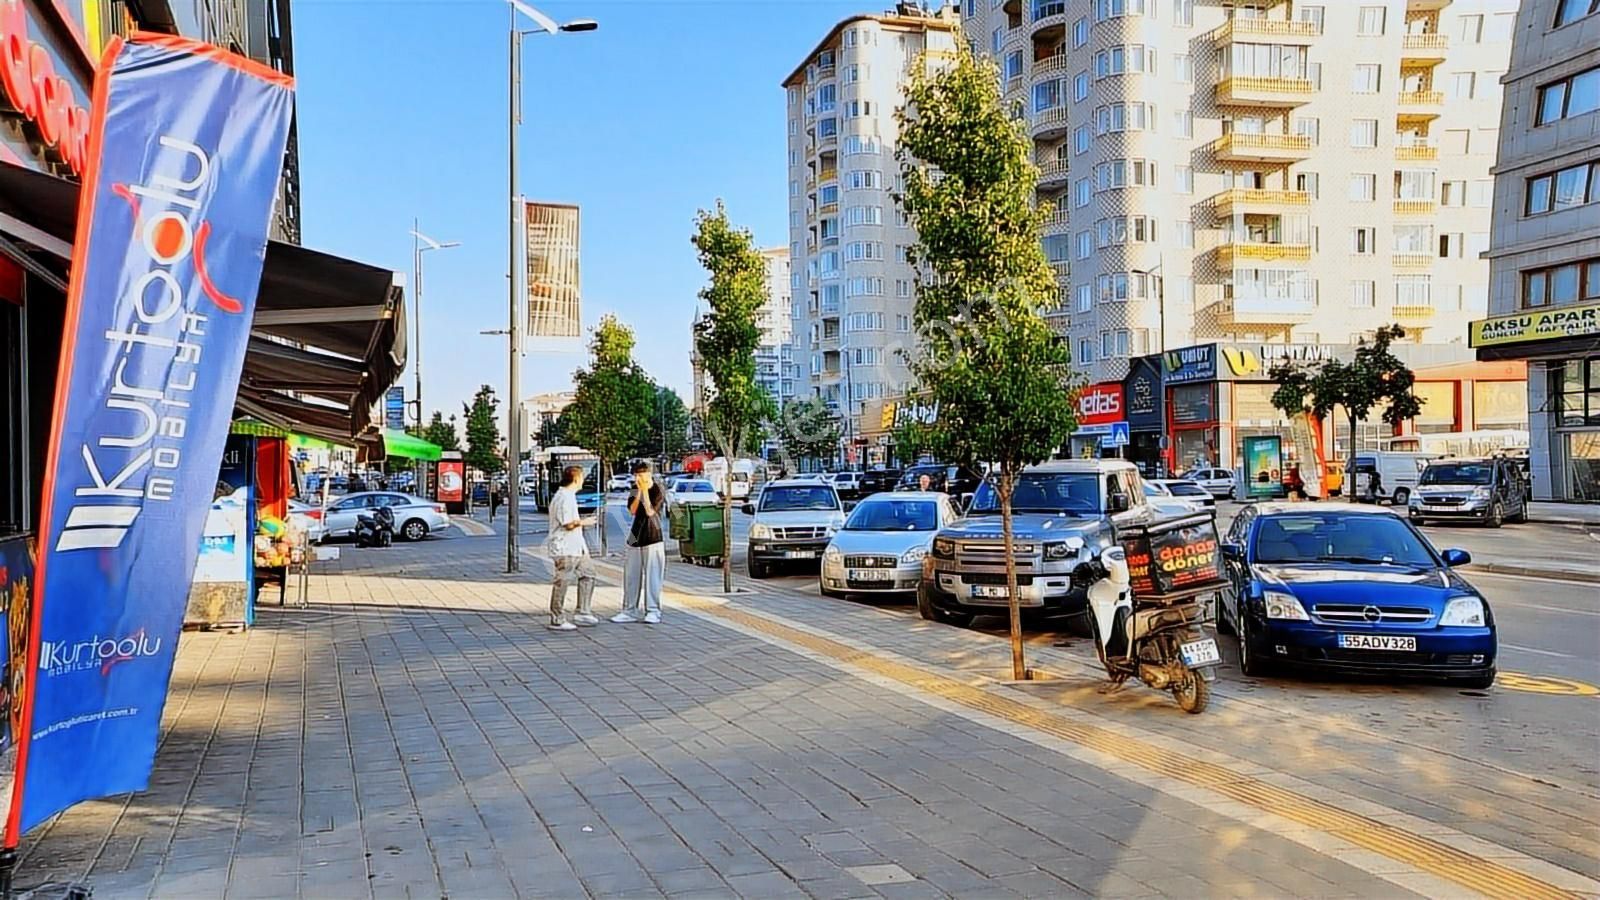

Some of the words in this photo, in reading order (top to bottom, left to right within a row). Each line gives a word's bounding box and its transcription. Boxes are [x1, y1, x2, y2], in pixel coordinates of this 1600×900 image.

[1482, 317, 1532, 333] AKSU
[1160, 540, 1216, 561] donas
[1163, 552, 1215, 571] döner
